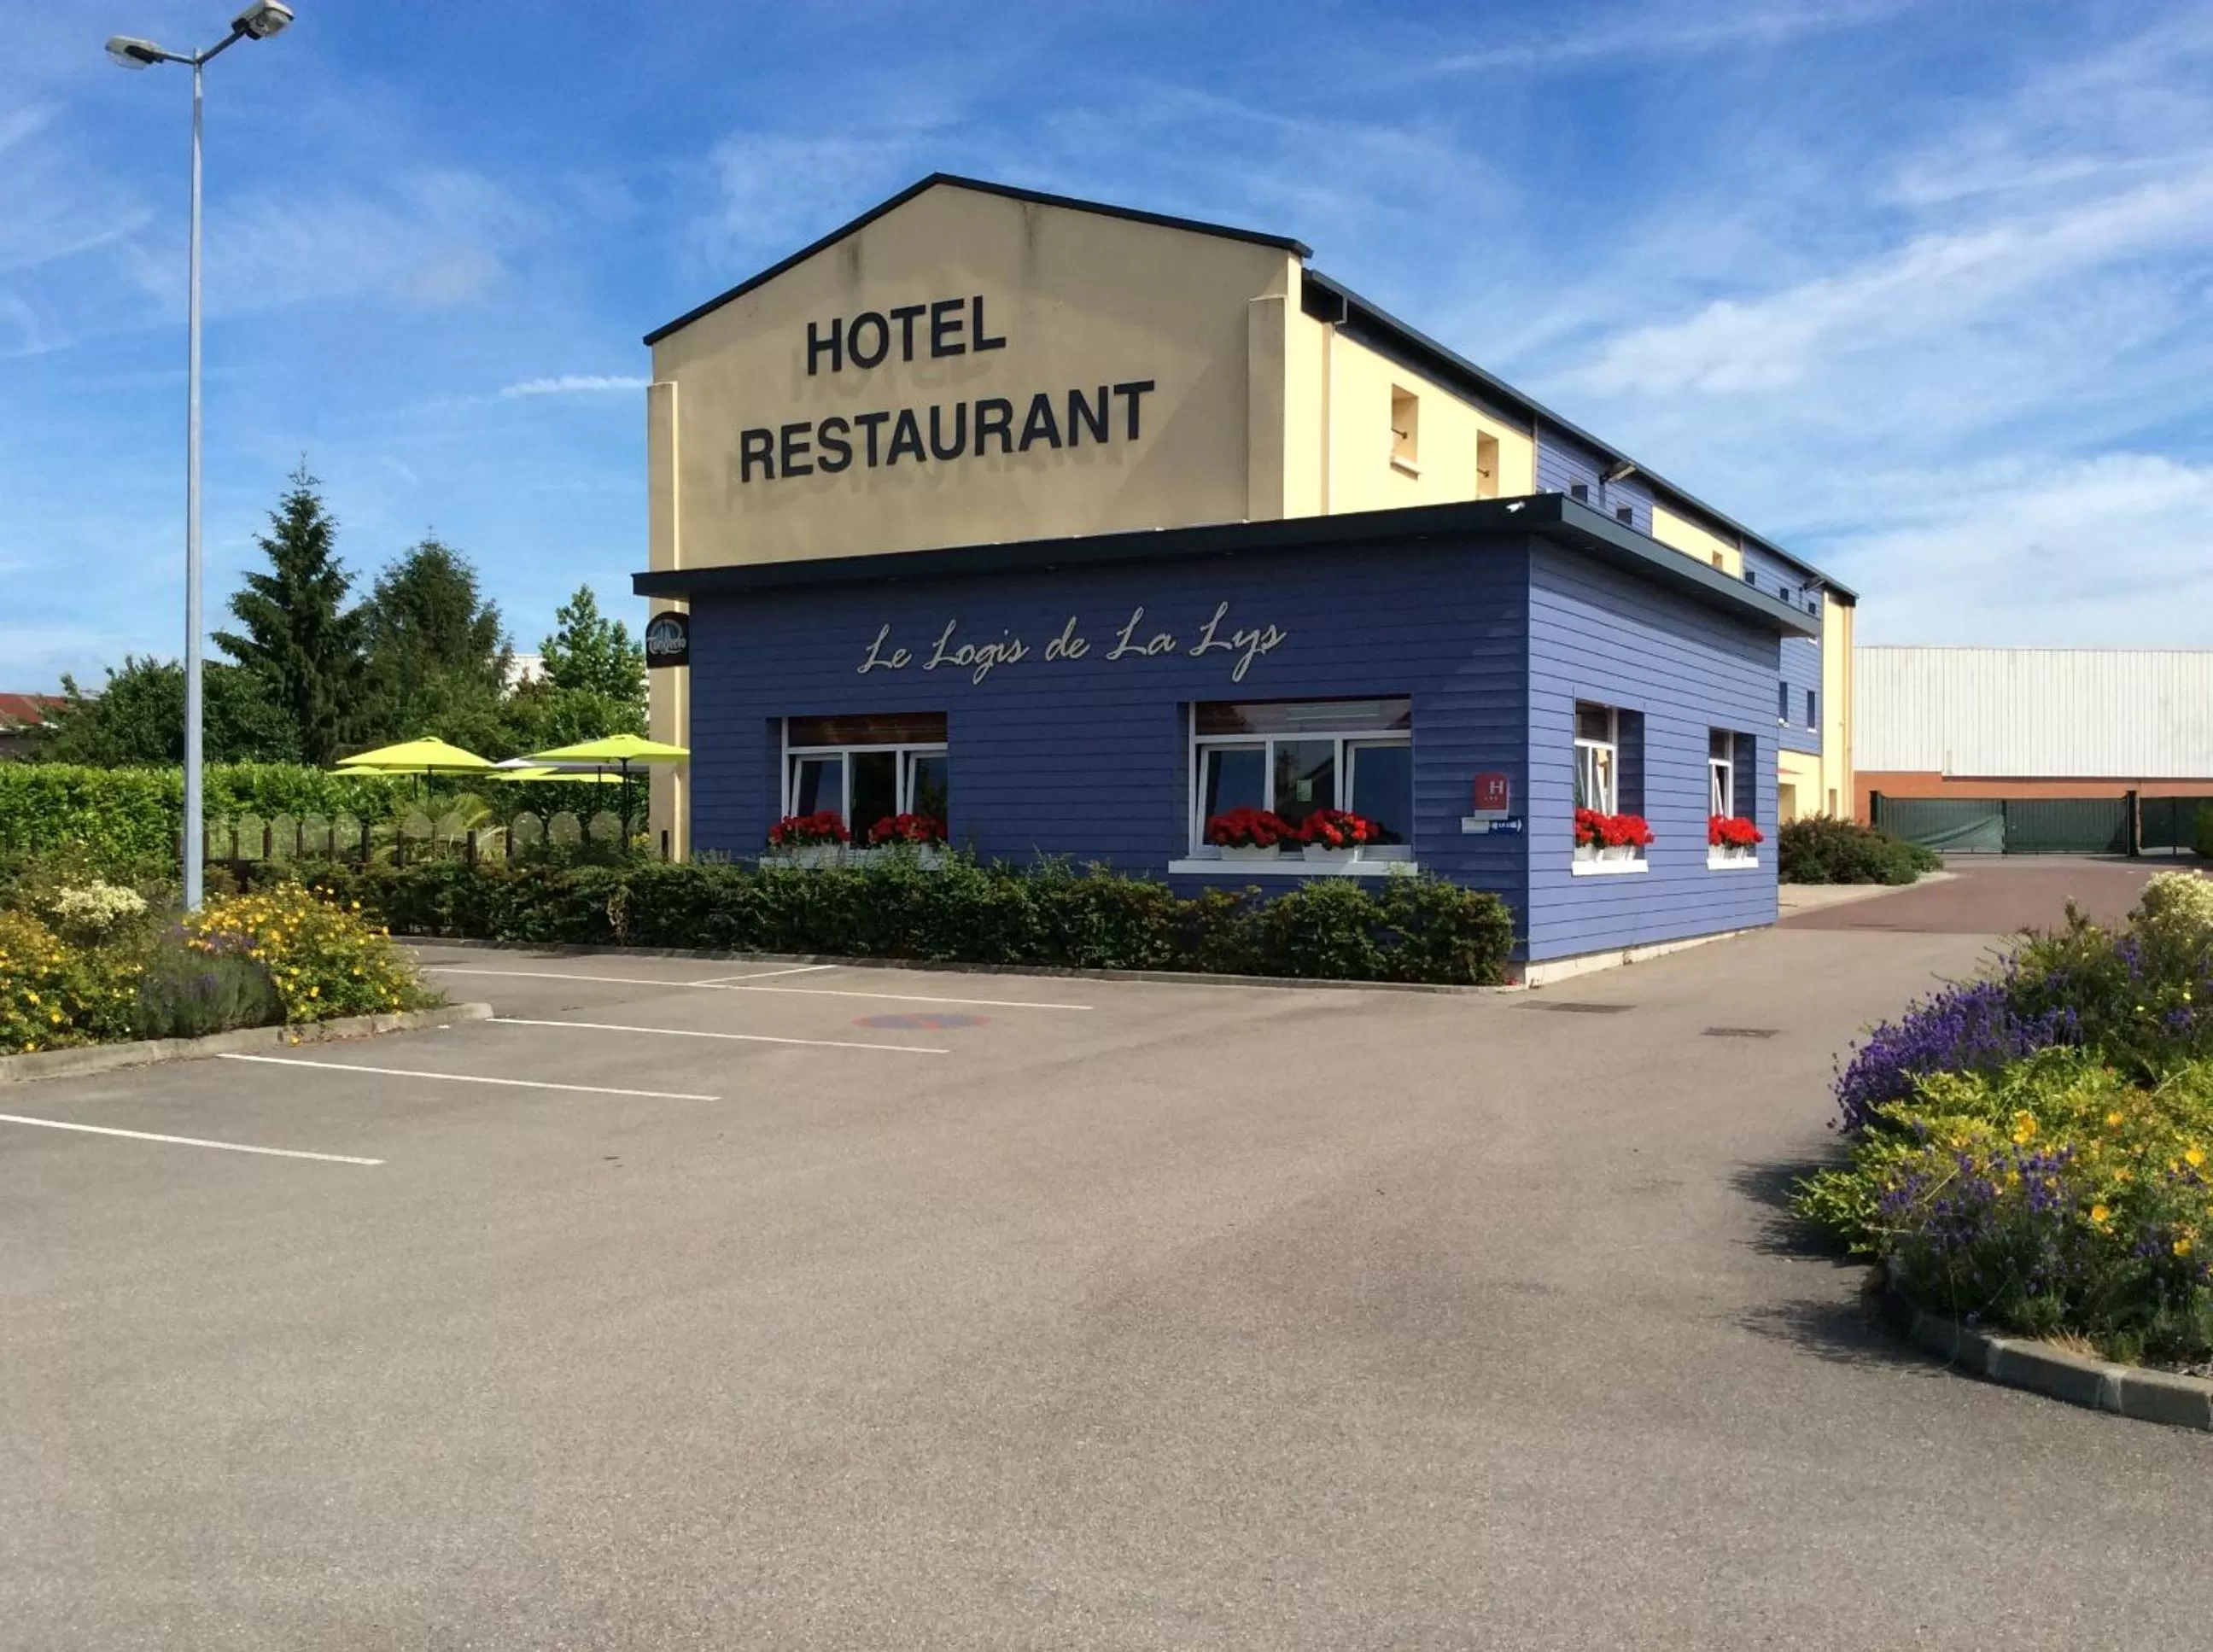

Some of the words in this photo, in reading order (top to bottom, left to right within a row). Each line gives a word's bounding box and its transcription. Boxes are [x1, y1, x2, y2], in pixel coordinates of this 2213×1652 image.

[807, 295, 1007, 376] HOTEL
[740, 380, 1155, 483] RESTAURANT
[857, 623, 913, 674] Le
[922, 619, 1031, 685] Logis
[1045, 616, 1091, 662] de
[1106, 605, 1177, 660] La
[1188, 601, 1288, 683] Lys
[1489, 779, 1504, 795] H
